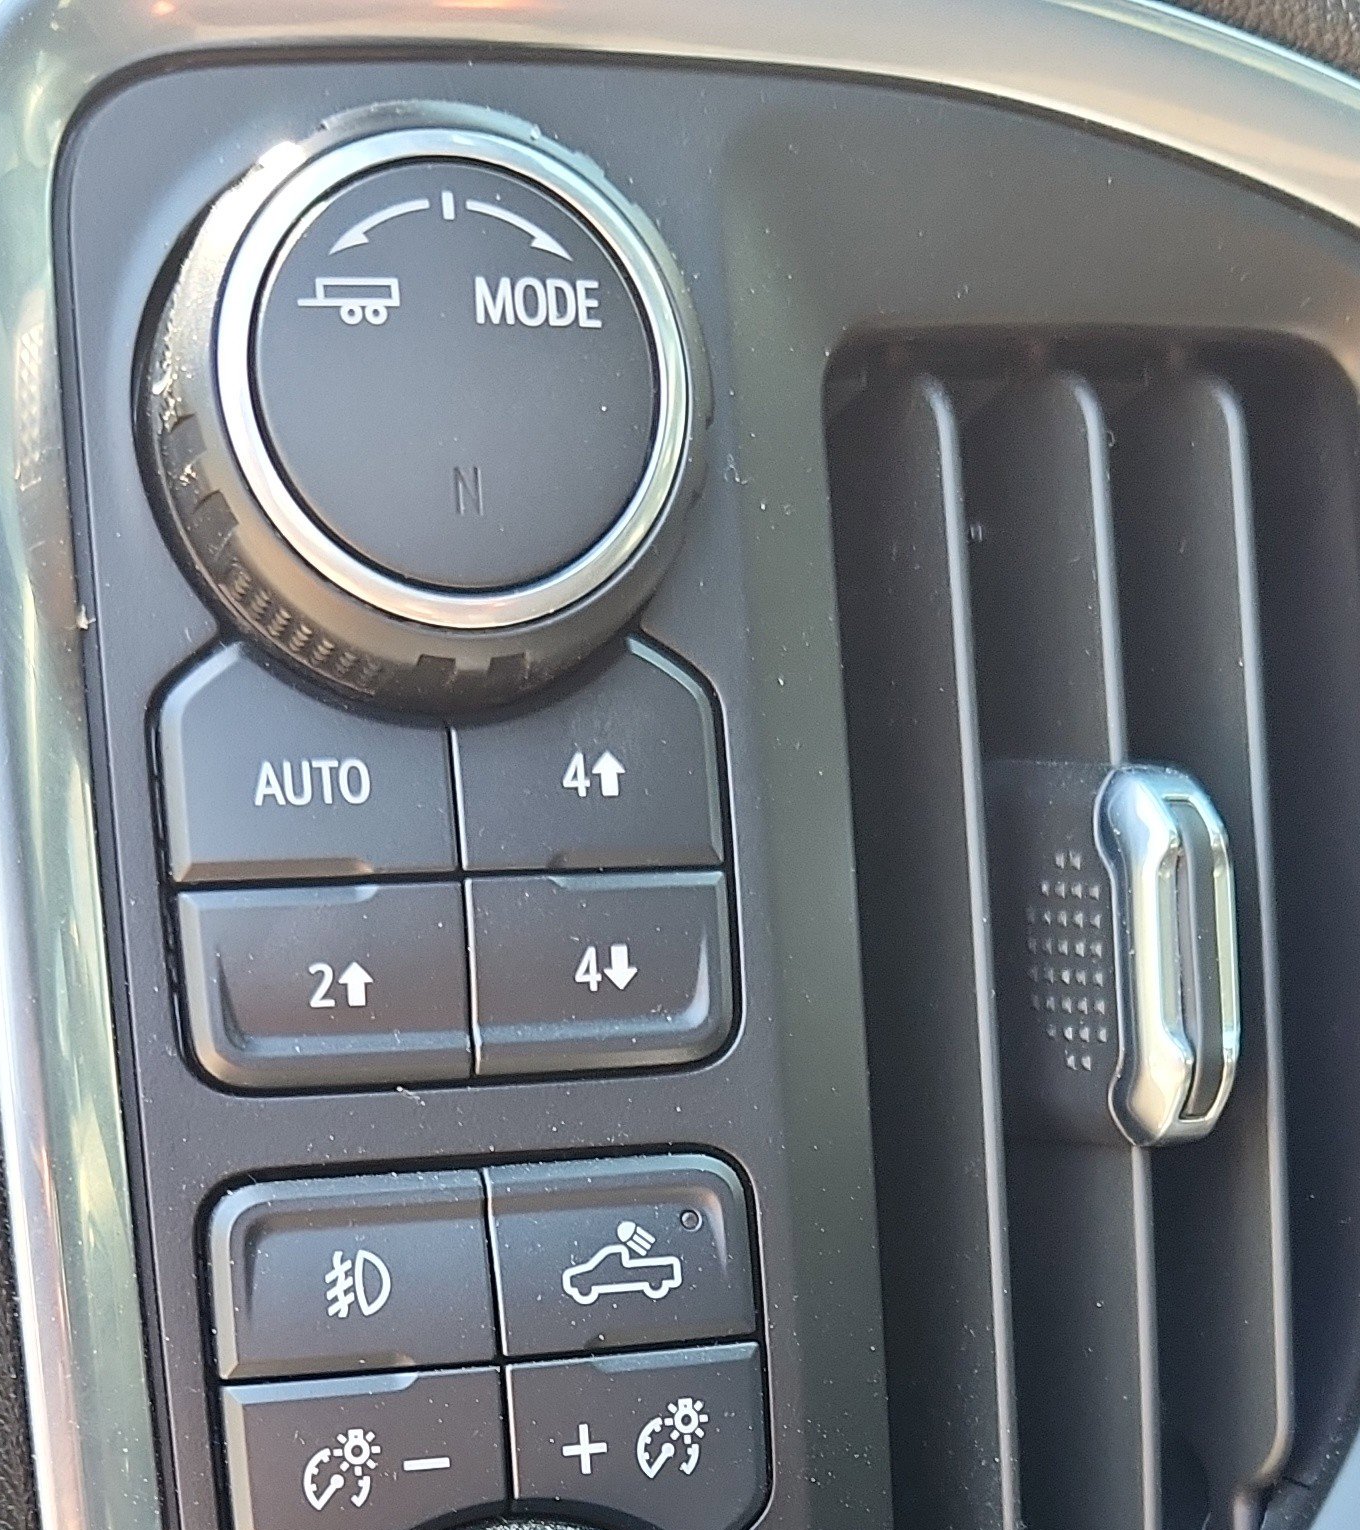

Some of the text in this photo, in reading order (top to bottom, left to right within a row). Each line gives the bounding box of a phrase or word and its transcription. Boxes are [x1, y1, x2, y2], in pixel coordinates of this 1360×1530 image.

[474, 275, 603, 329] MODE
[452, 467, 484, 516] N
[253, 757, 372, 806] AUTO
[562, 752, 591, 799] 4
[308, 963, 336, 1009] 2
[574, 946, 602, 992] 4
